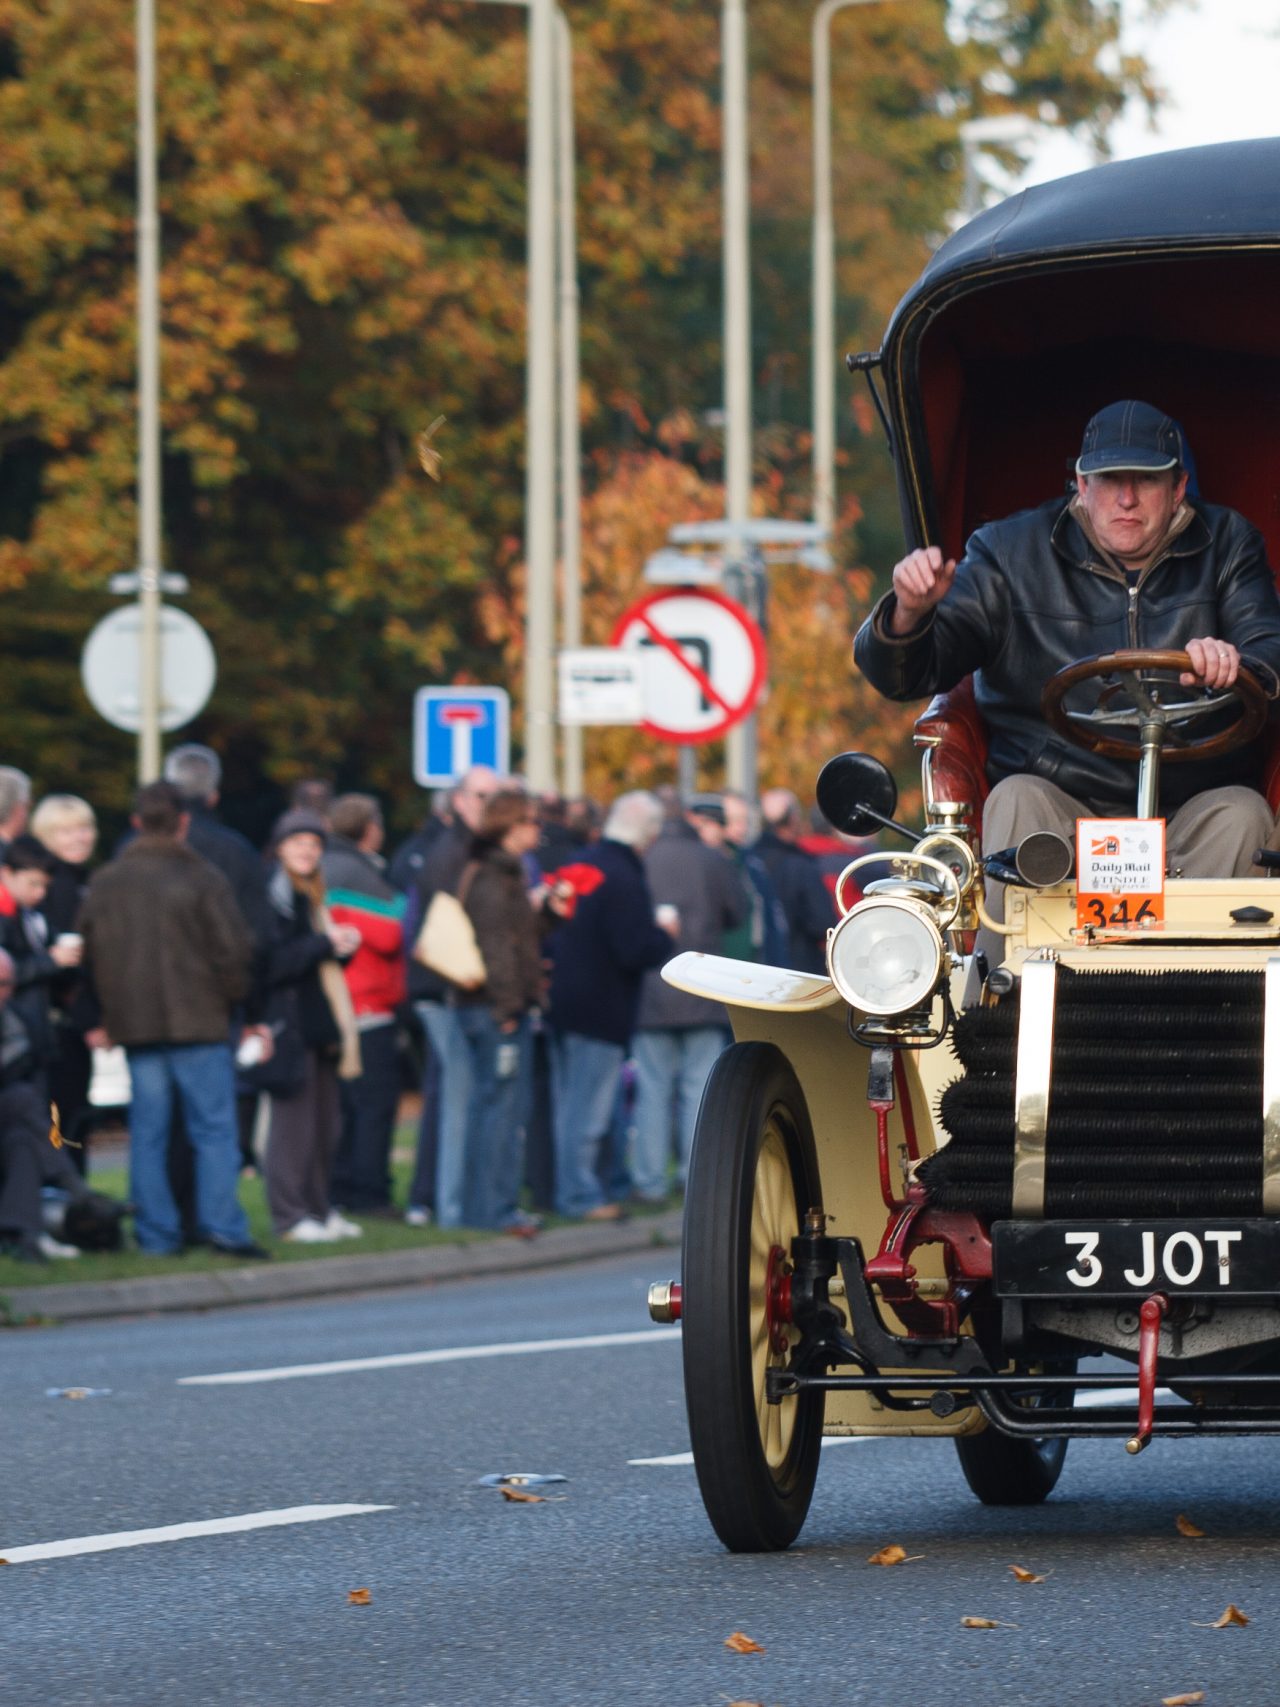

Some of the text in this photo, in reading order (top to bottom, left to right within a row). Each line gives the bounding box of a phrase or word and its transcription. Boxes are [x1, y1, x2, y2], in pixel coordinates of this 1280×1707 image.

[1092, 862, 1150, 874] Daily Mail
[1088, 898, 1157, 928] 346
[1065, 1231, 1242, 1287] 3 JOT
